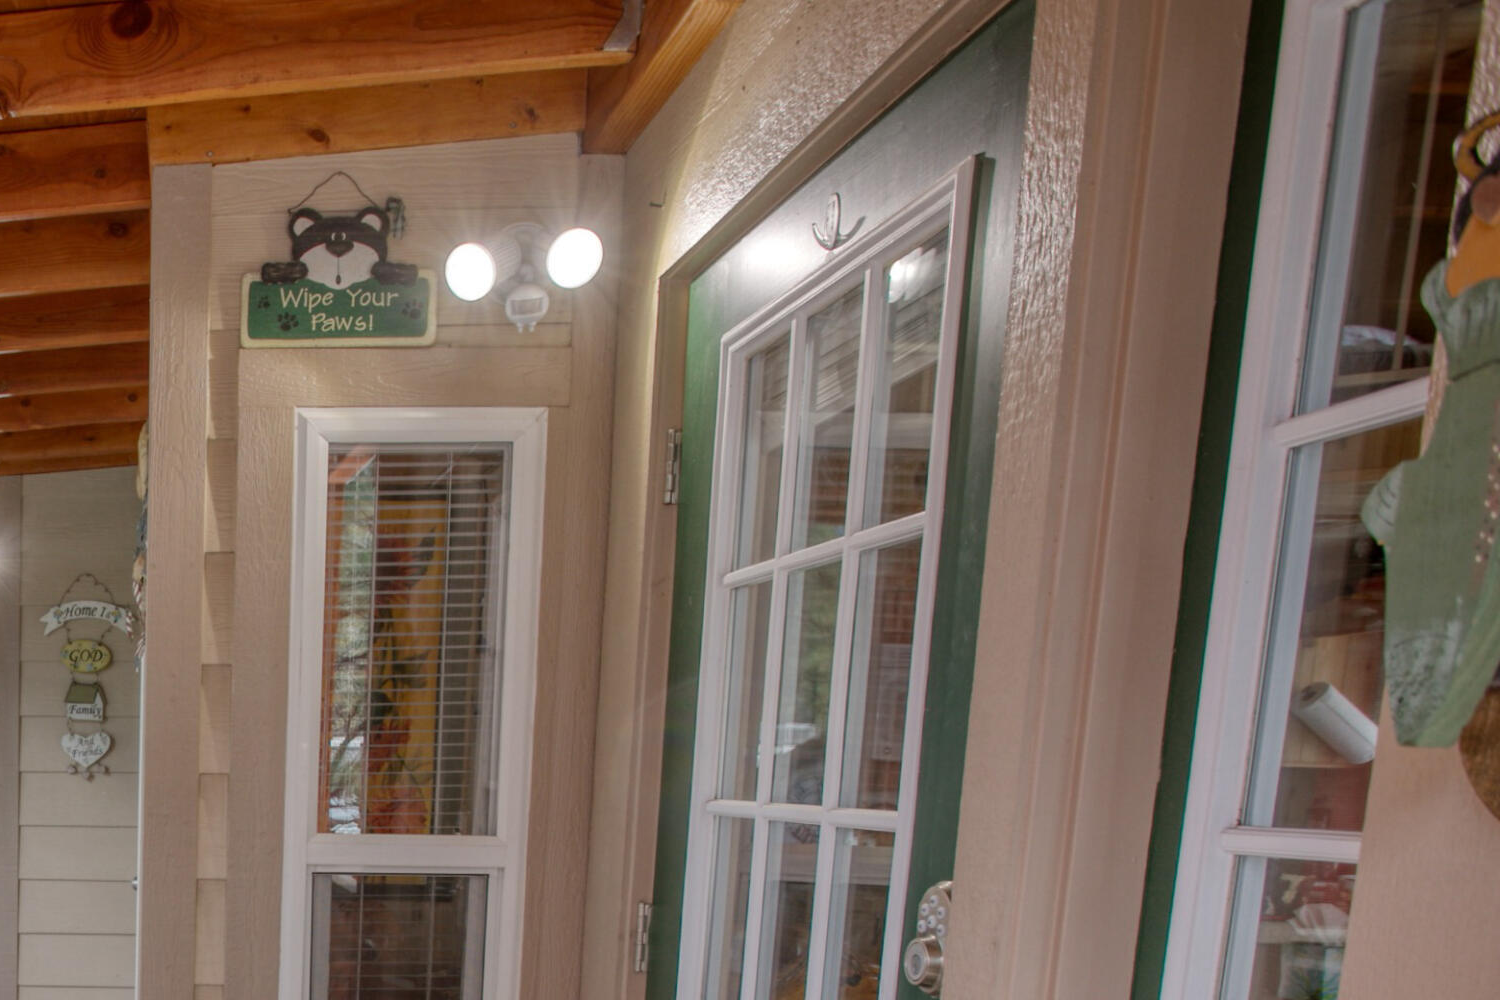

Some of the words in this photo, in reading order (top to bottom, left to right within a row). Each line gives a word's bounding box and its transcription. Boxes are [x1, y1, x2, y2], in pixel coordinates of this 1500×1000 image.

[280, 287, 334, 313] Wipe
[346, 288, 399, 308] Your
[311, 312, 374, 332] Paws!
[64, 603, 98, 618] Home
[69, 648, 104, 664] GOD
[69, 704, 102, 719] Family
